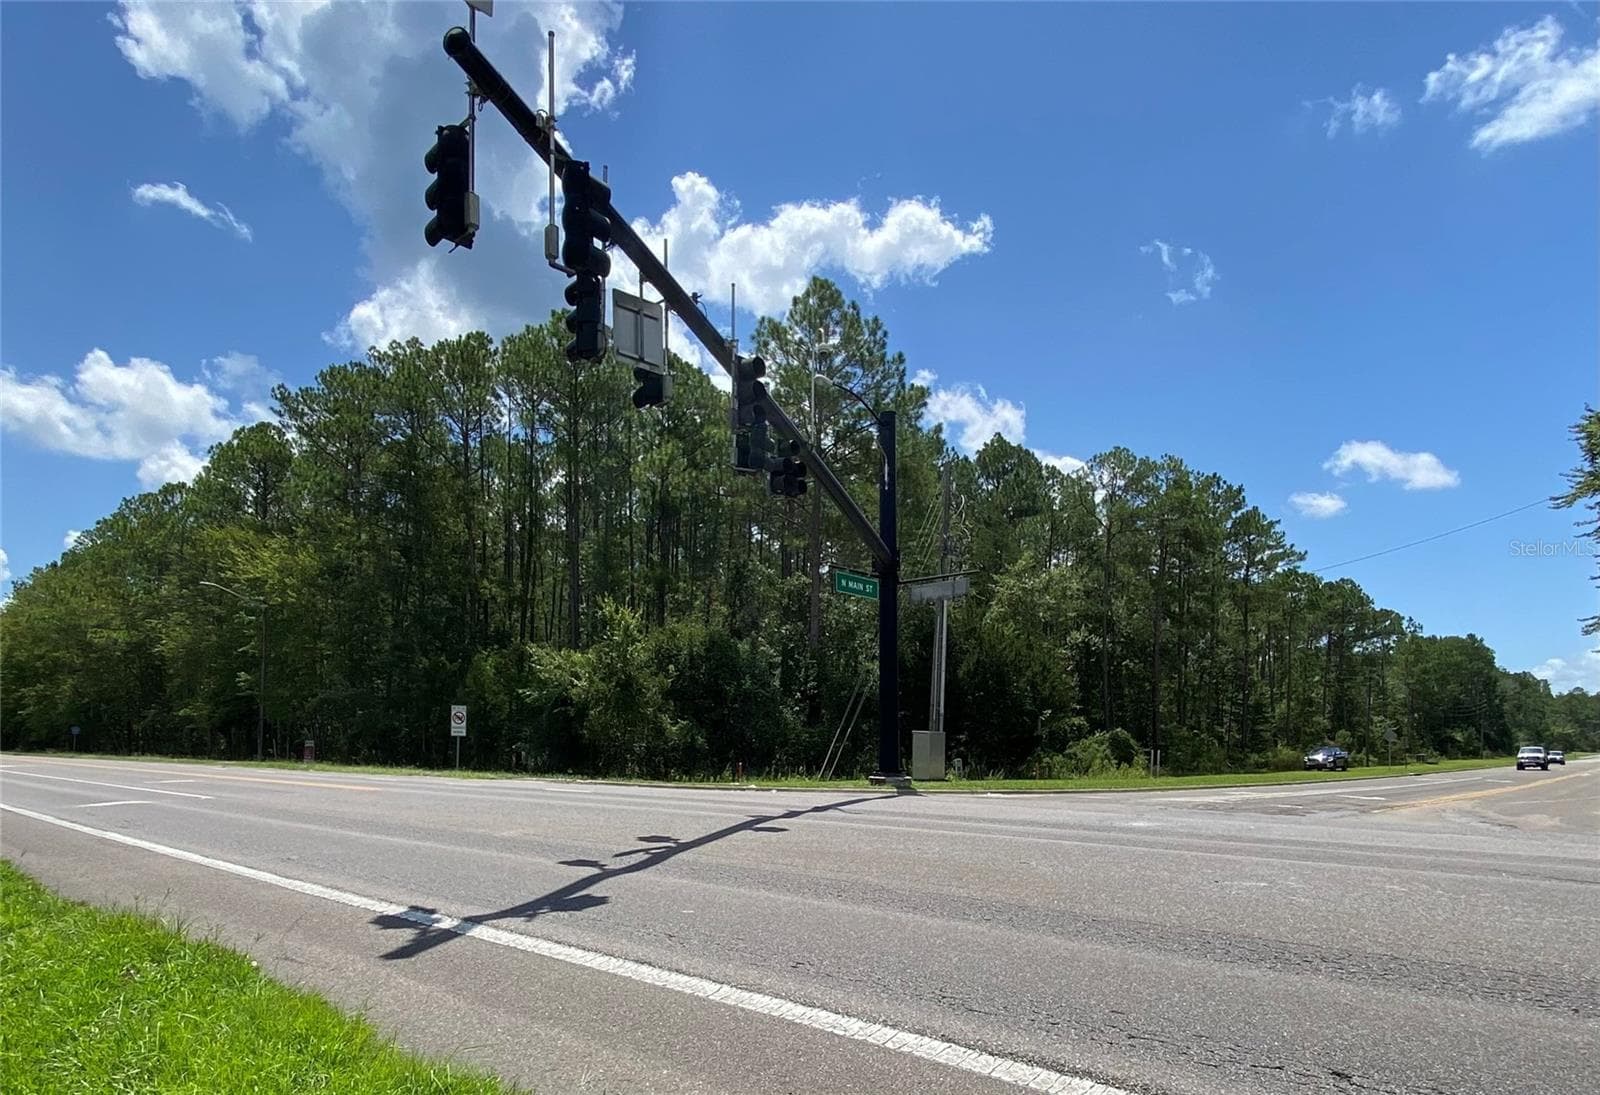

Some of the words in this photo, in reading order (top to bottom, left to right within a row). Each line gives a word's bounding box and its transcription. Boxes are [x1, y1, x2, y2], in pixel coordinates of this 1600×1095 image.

[841, 579, 847, 587] N
[848, 580, 864, 591] MAIN
[865, 584, 873, 593] ST
